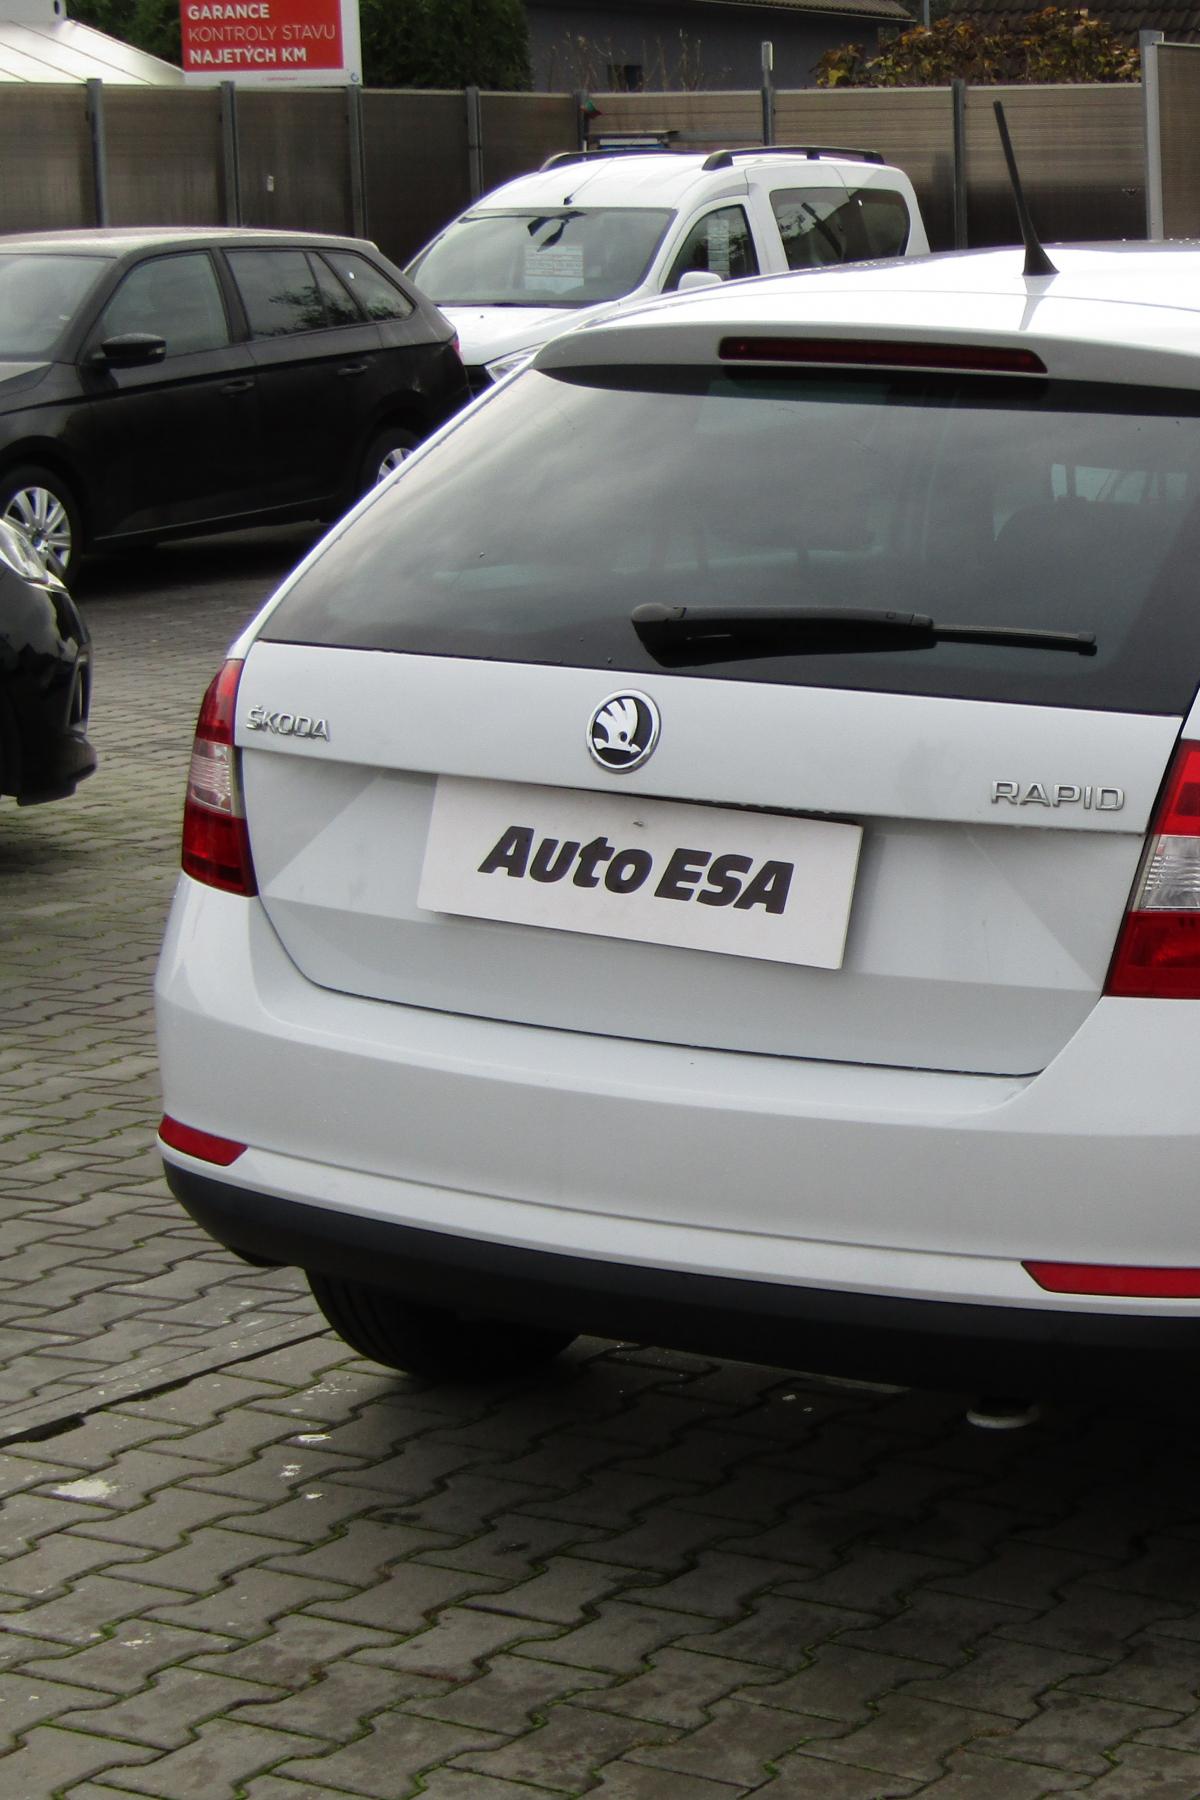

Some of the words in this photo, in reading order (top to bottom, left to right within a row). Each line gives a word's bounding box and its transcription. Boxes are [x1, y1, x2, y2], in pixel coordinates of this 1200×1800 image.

[188, 4, 270, 20] GARANCE
[188, 25, 278, 42] KONTROLY
[282, 24, 336, 40] STAVU
[189, 45, 276, 64] NAJETÝCH
[282, 48, 307, 63] KM
[246, 704, 330, 742] ŠKODA
[991, 780, 1125, 811] RAPID
[477, 825, 652, 894] Auto
[654, 848, 795, 915] ESA
